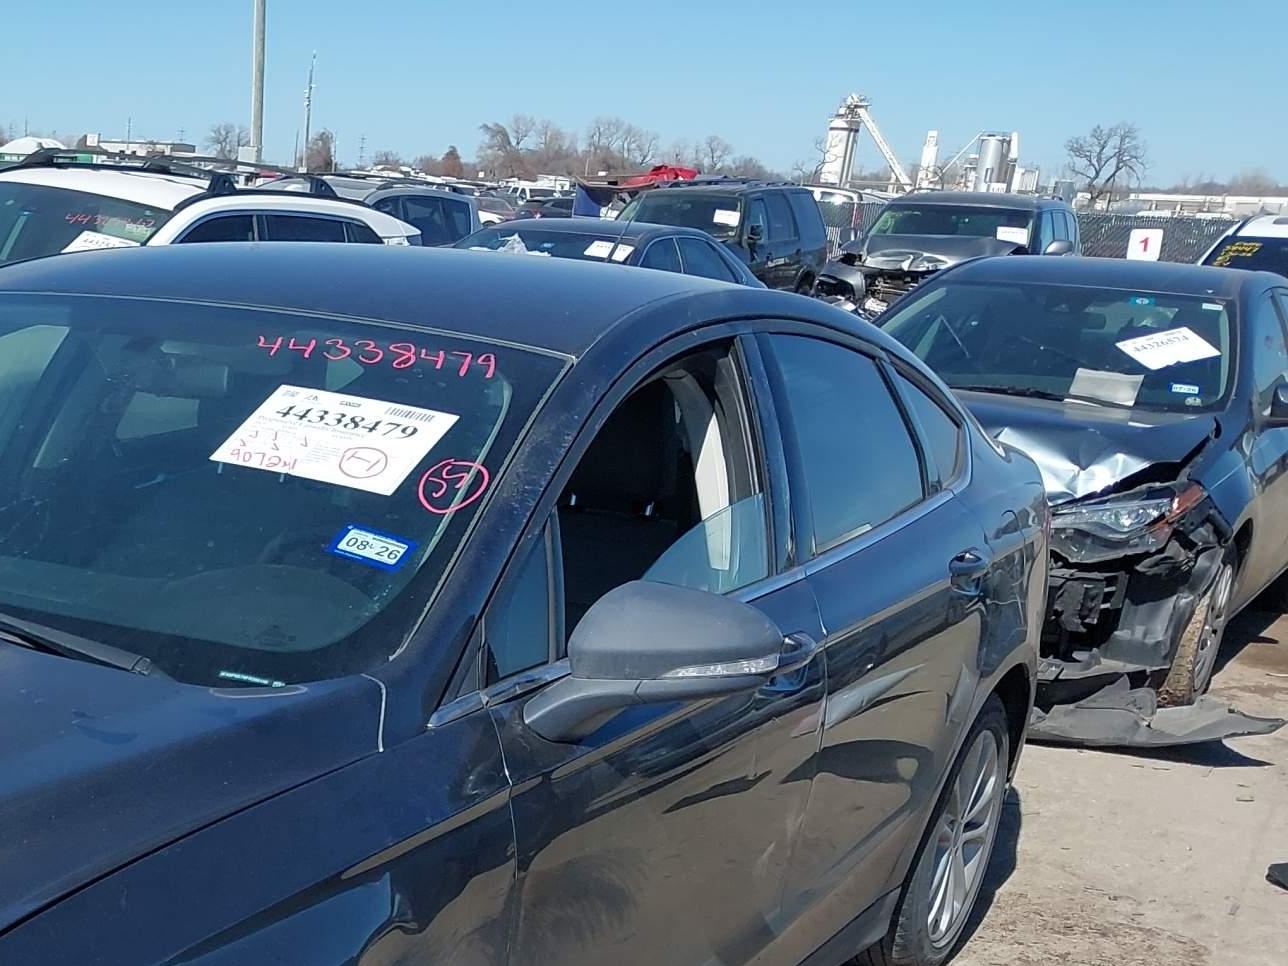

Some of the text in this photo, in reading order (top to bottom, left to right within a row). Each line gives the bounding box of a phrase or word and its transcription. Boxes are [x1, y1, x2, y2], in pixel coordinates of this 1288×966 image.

[1139, 237, 1150, 252] 1
[257, 335, 496, 379] 44338479
[276, 404, 418, 439] 44338479
